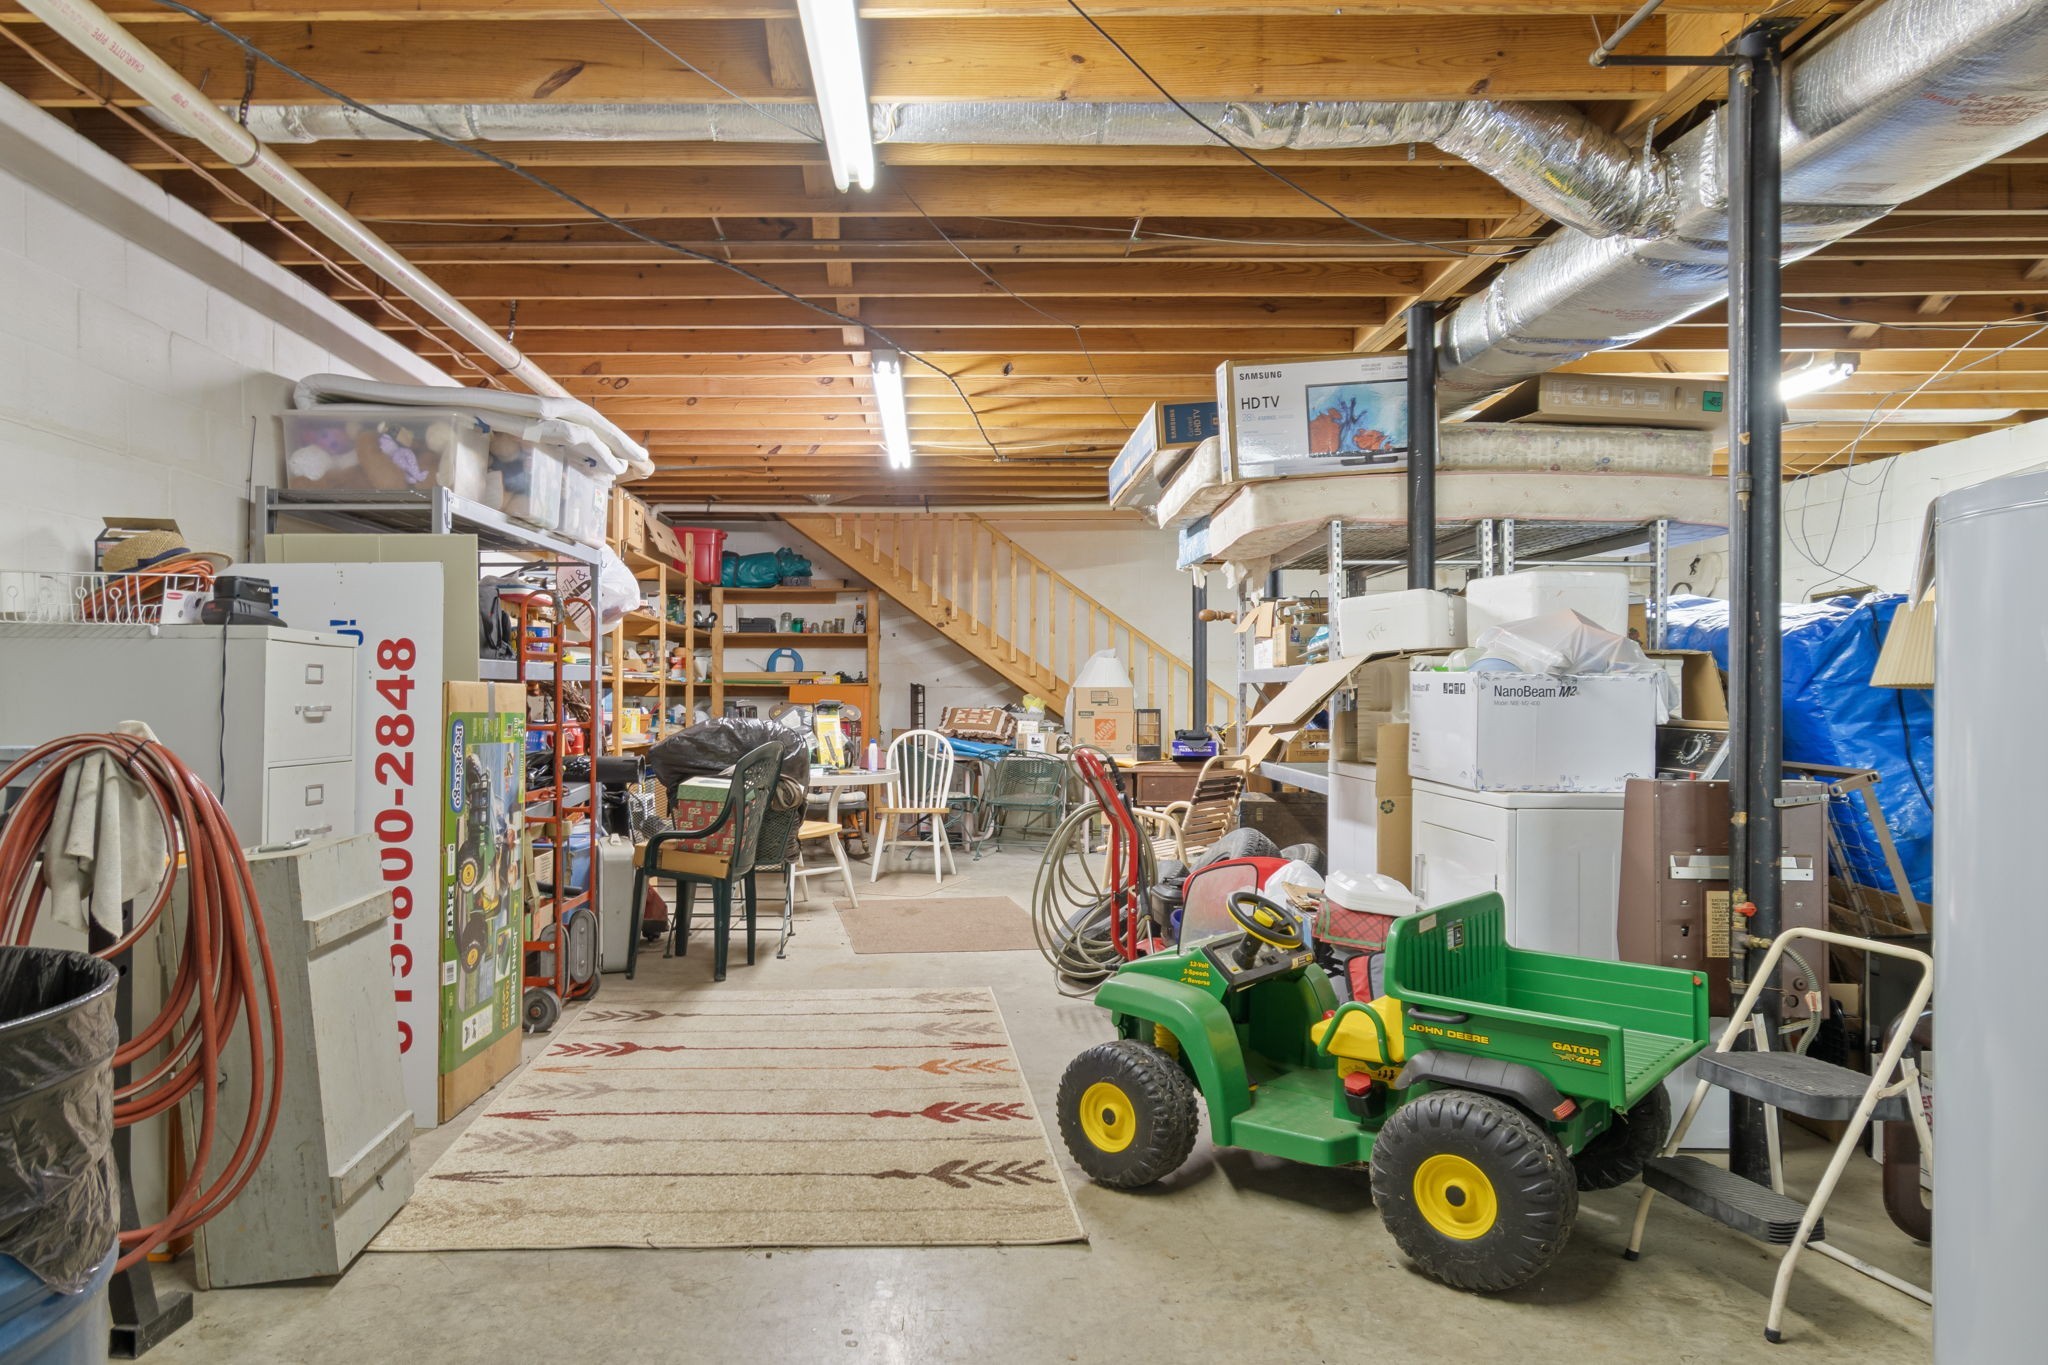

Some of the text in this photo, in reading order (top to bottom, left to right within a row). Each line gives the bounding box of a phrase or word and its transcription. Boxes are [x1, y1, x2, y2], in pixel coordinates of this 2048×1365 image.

[91, 27, 145, 73] CHARLOTTE PIPE
[1239, 370, 1283, 381] SAMSUNG
[1494, 685, 1578, 698] NanoBeam M2
[451, 725, 464, 809] Peg-Pérego
[509, 971, 518, 1026] DEERE
[1408, 1023, 1489, 1044] JOHN DEERE
[1551, 1041, 1600, 1057] GATOR
[1576, 1056, 1602, 1067] 4x2
